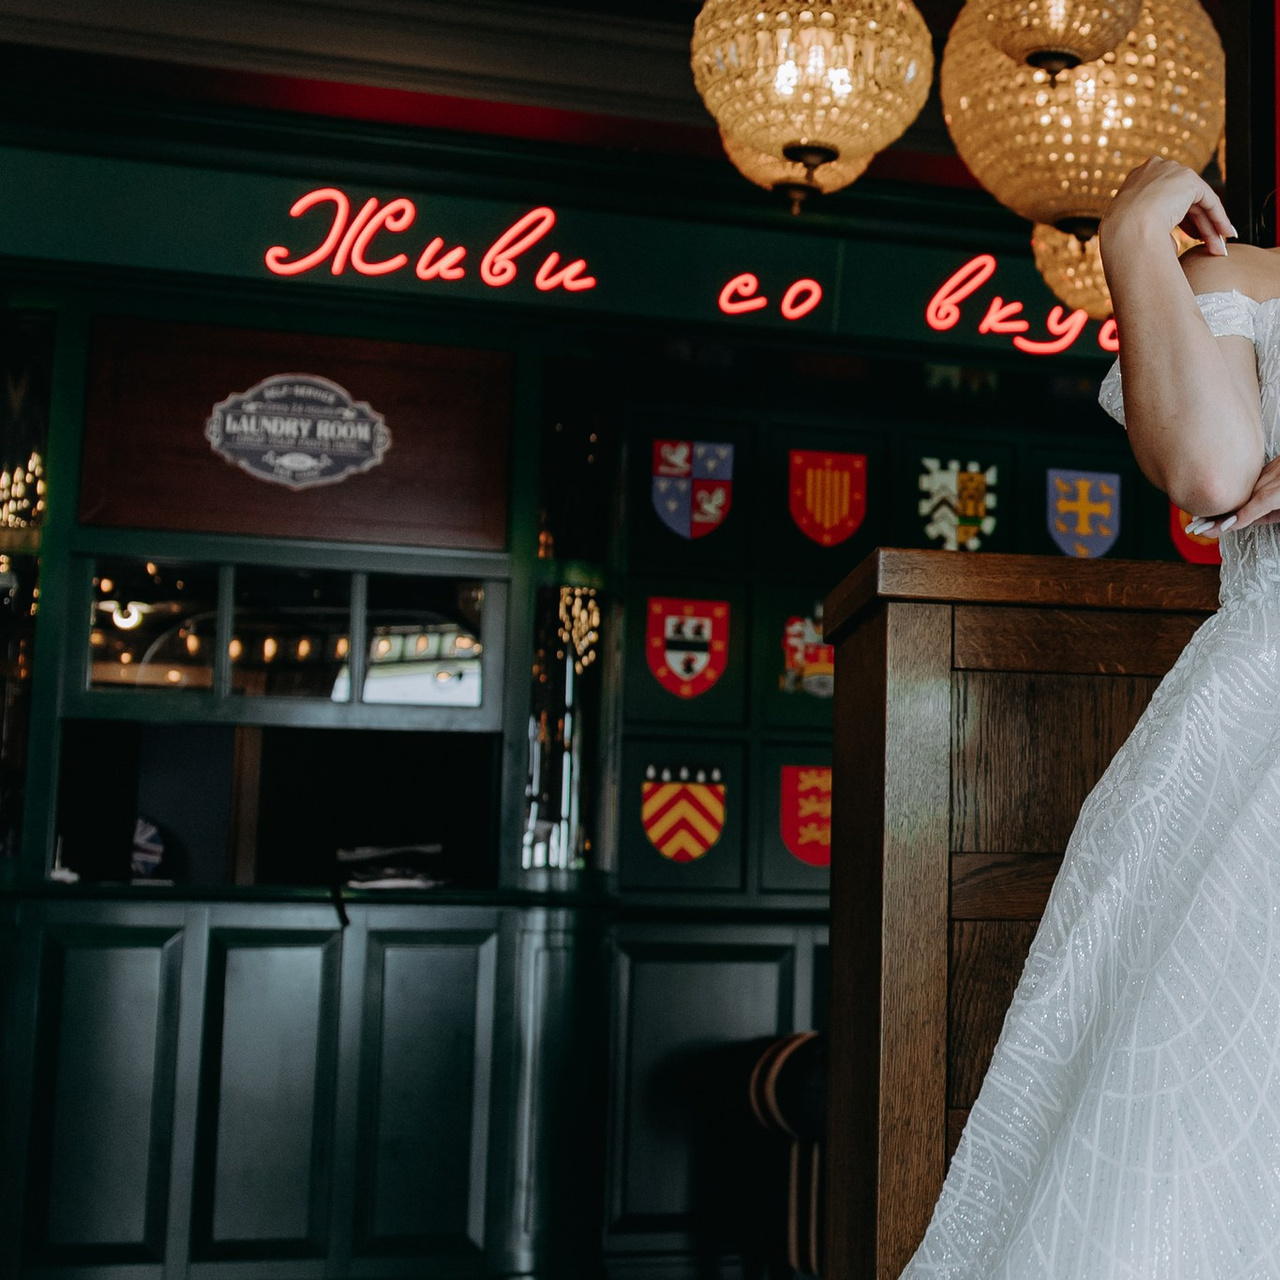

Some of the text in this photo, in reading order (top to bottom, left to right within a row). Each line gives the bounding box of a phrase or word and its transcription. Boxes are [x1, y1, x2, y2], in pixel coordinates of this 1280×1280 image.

[264, 187, 597, 292] Живи
[718, 272, 822, 320] со
[225, 413, 312, 438] LAUNDRY
[316, 419, 371, 443] ROOM
